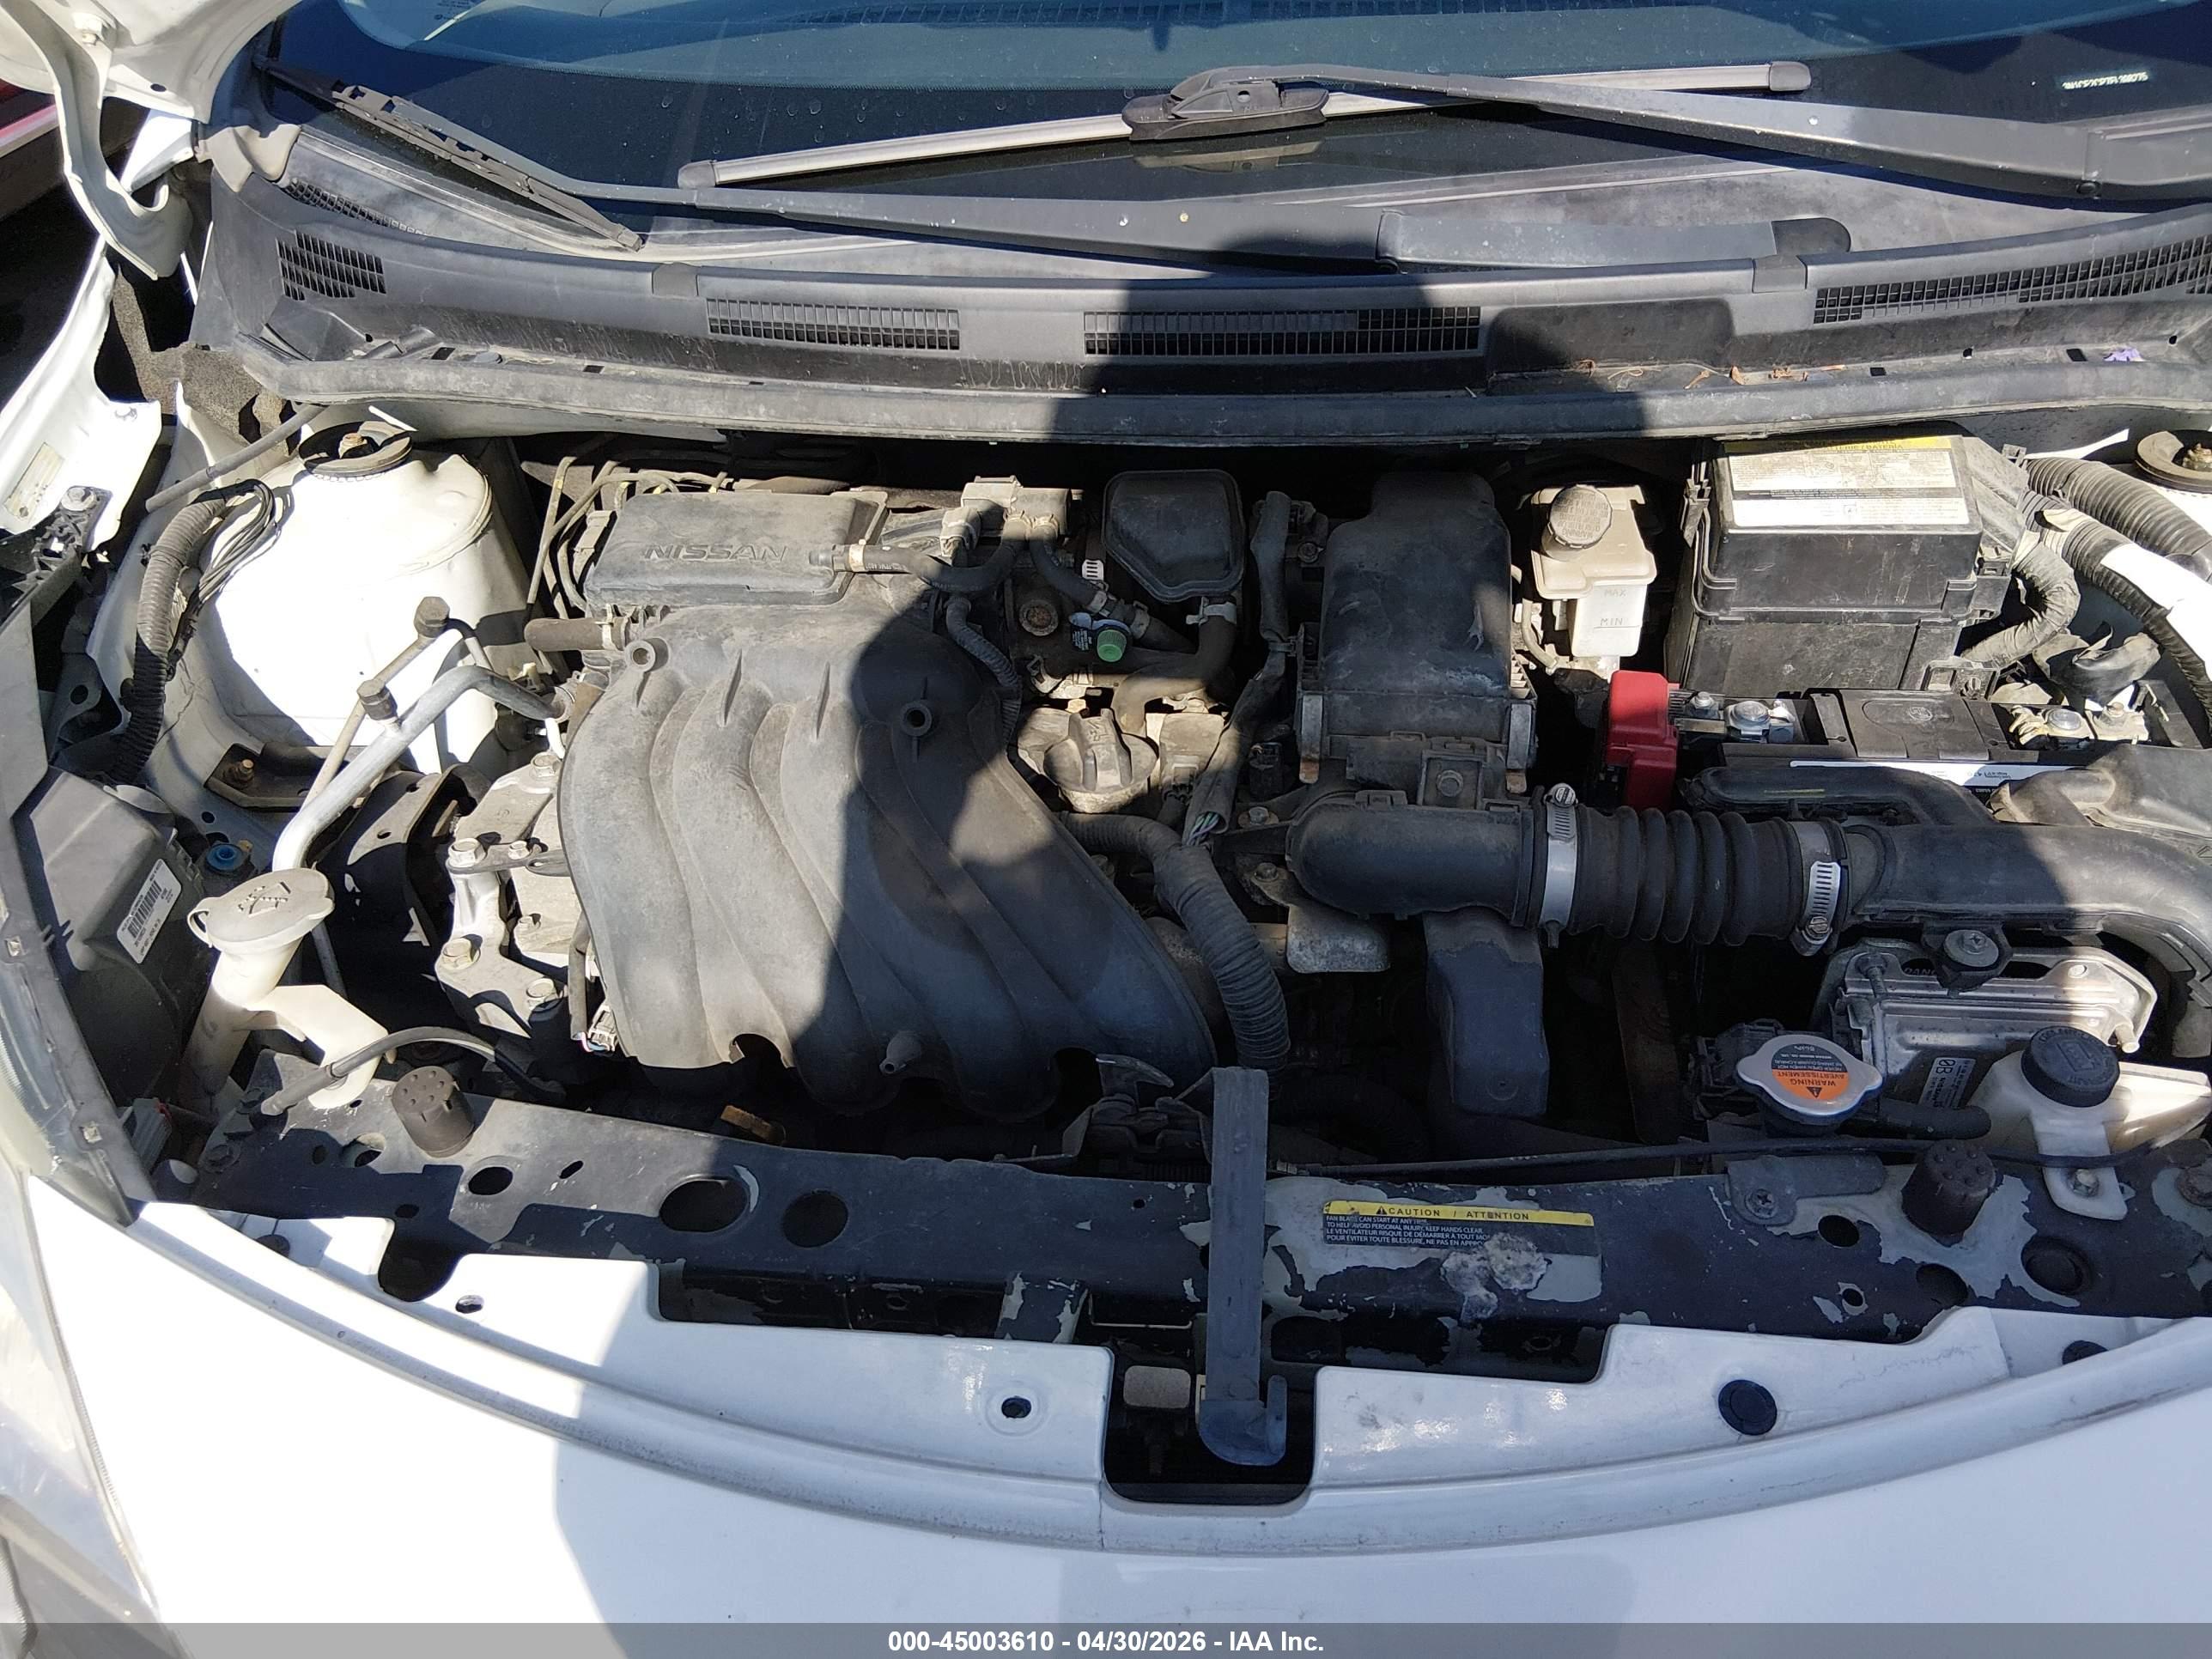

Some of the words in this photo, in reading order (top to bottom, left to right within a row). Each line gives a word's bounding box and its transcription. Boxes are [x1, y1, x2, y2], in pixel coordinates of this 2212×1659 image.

[644, 544, 787, 562] NISSAN
[1603, 588, 1628, 598] MAX
[1600, 617, 1623, 627] MIN
[1777, 1071, 1844, 1079] AVERTISSEMENT
[1389, 1207, 1440, 1217] CAUTION
[1466, 1211, 1529, 1220] ATTENTION
[1413, 1231, 1450, 1239] DÉMARRER
